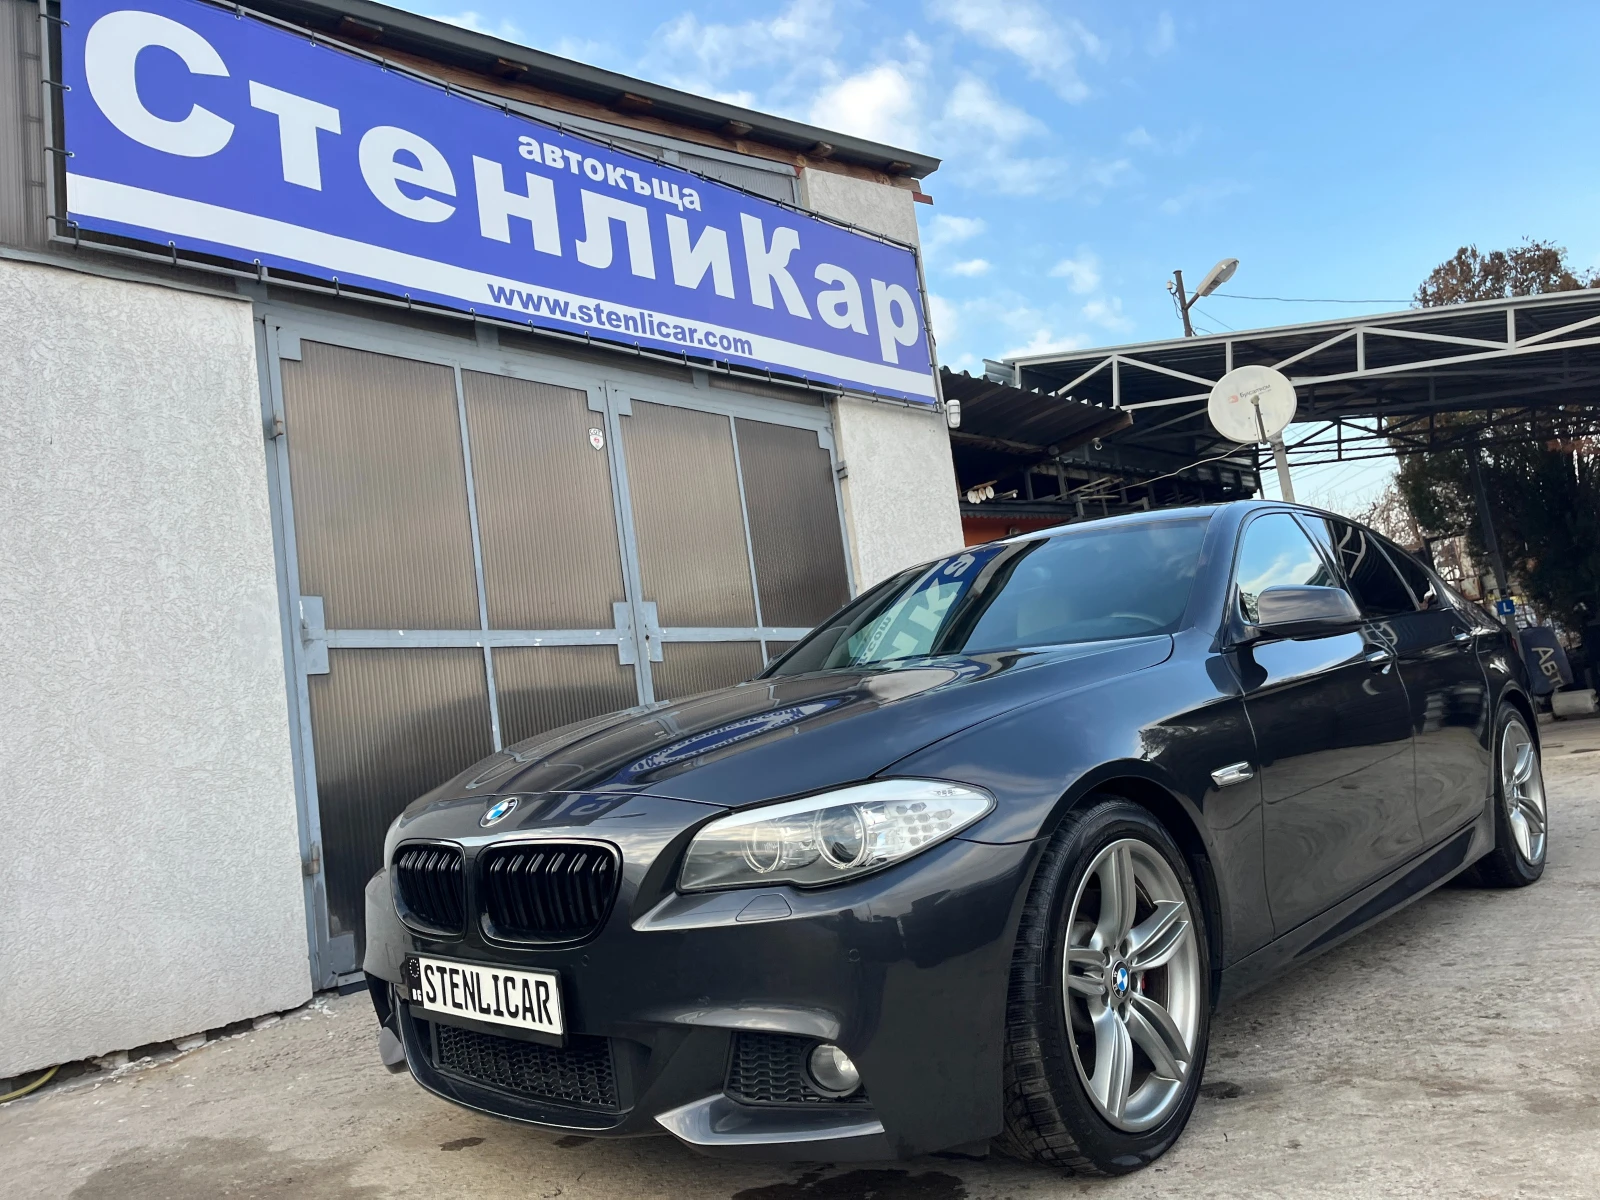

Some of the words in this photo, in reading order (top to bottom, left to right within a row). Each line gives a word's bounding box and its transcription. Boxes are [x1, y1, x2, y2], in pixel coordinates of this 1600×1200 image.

[84, 9, 919, 364] СтенлиКар
[518, 135, 702, 211] автокъща
[487, 283, 753, 356] www.stenlicar.com
[1503, 602, 1511, 612] L
[424, 964, 553, 1026] STENLICAR
